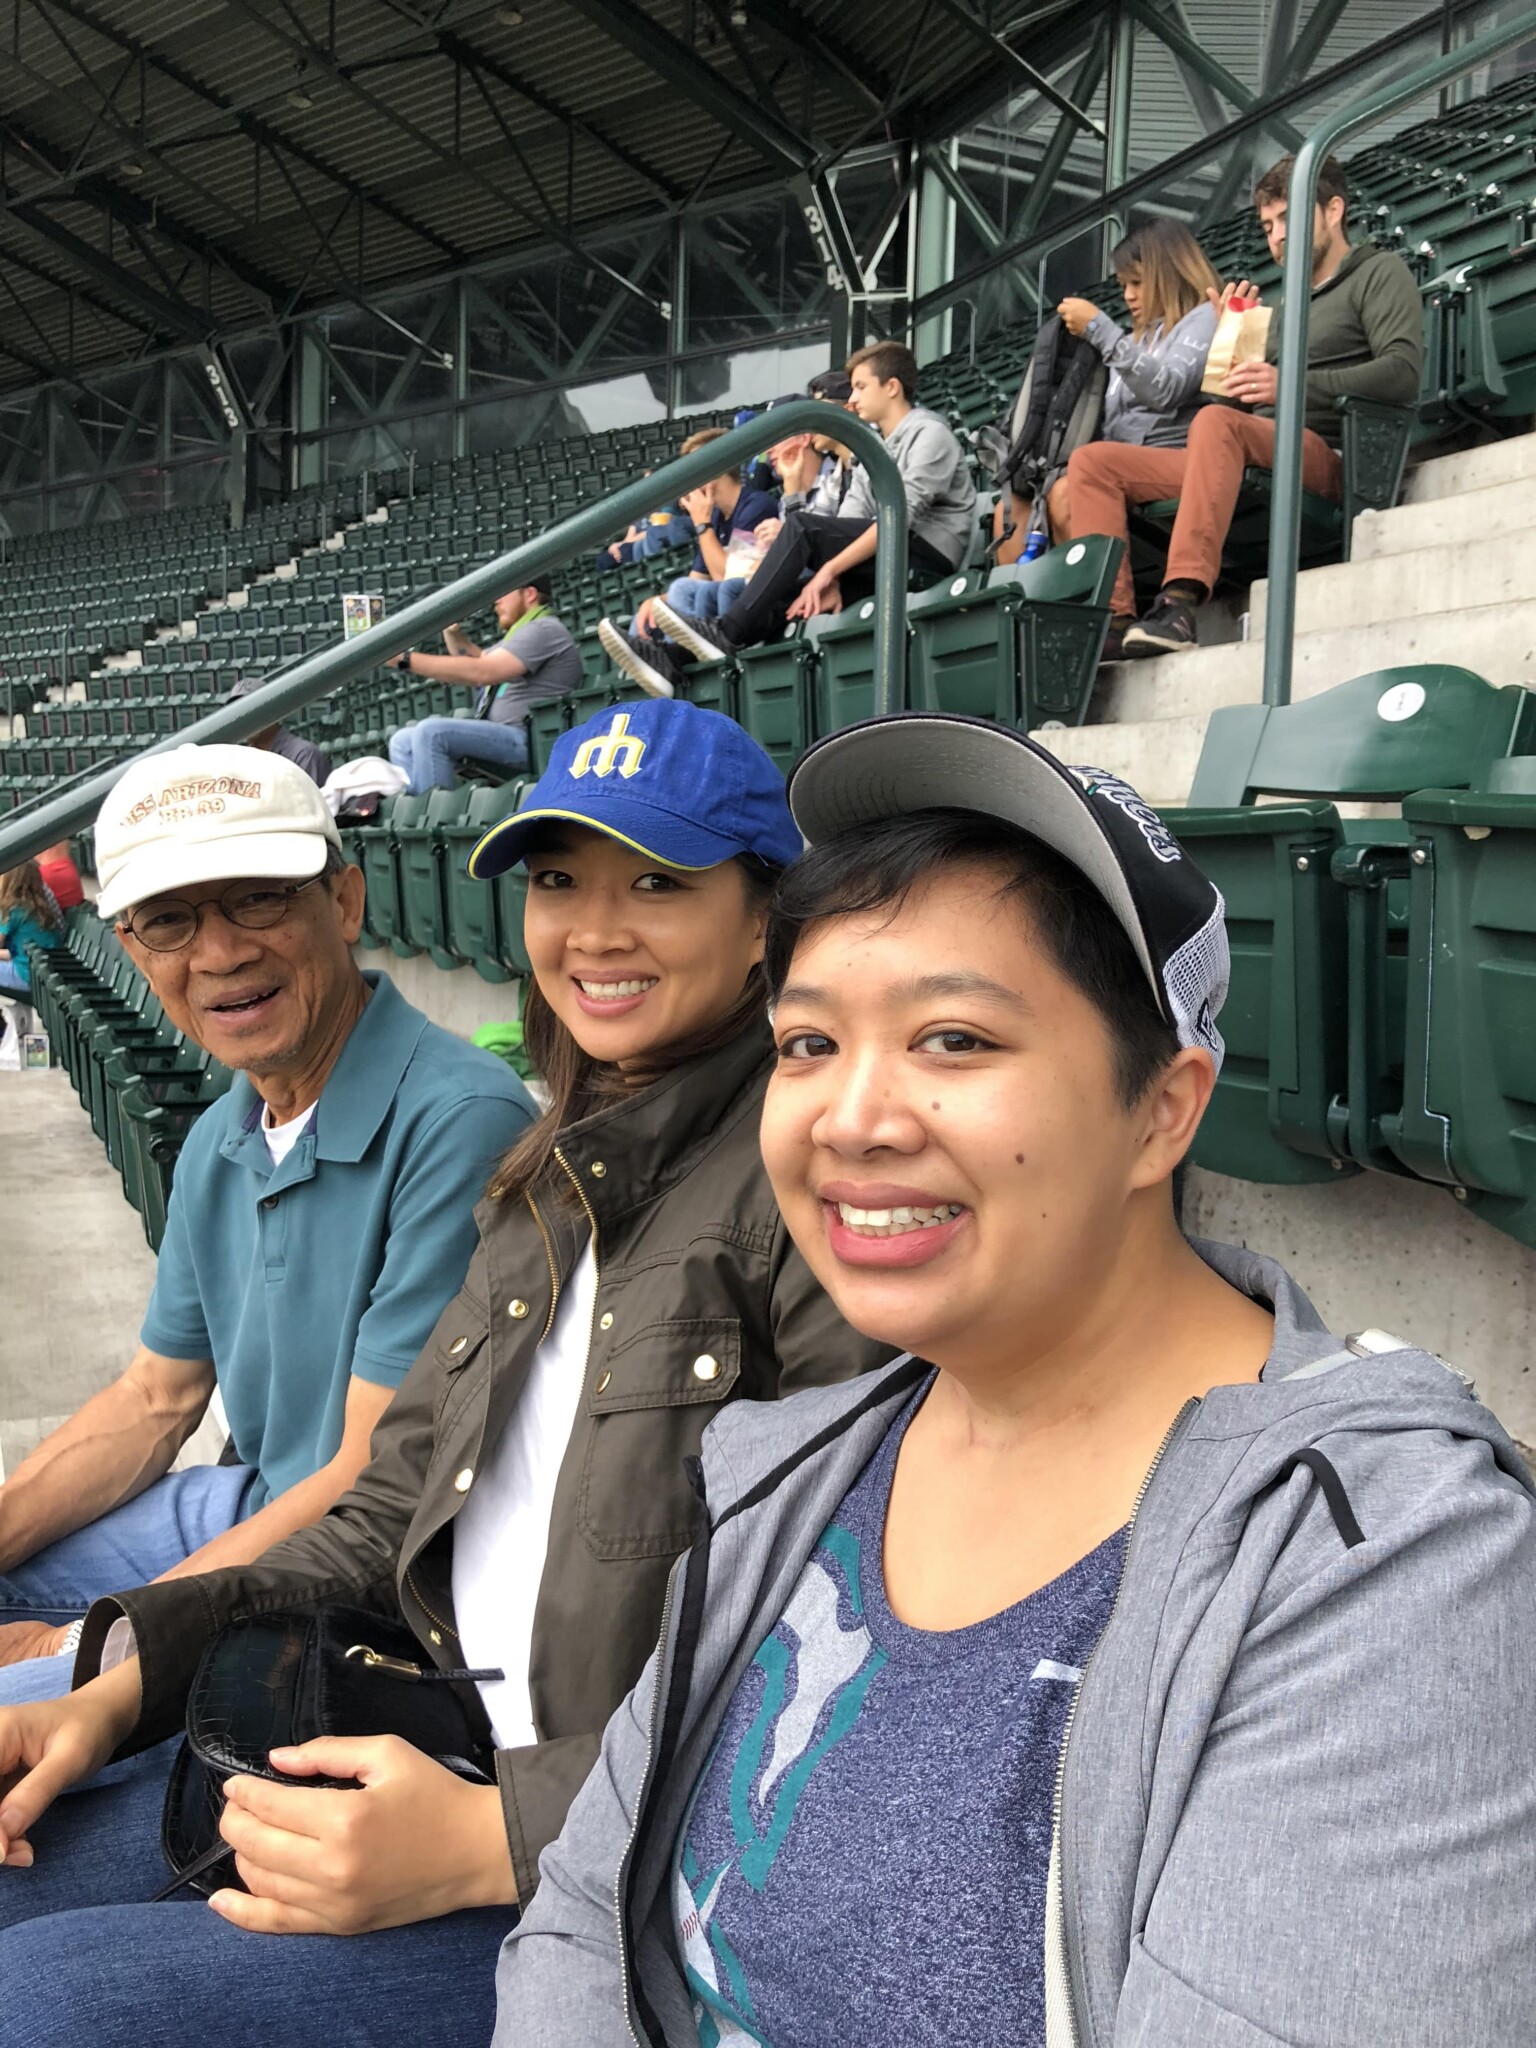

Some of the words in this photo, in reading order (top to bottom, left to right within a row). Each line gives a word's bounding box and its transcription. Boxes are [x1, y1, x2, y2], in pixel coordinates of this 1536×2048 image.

[803, 205, 844, 291] 314
[205, 364, 239, 427] 313
[158, 776, 262, 806] ARIZONA
